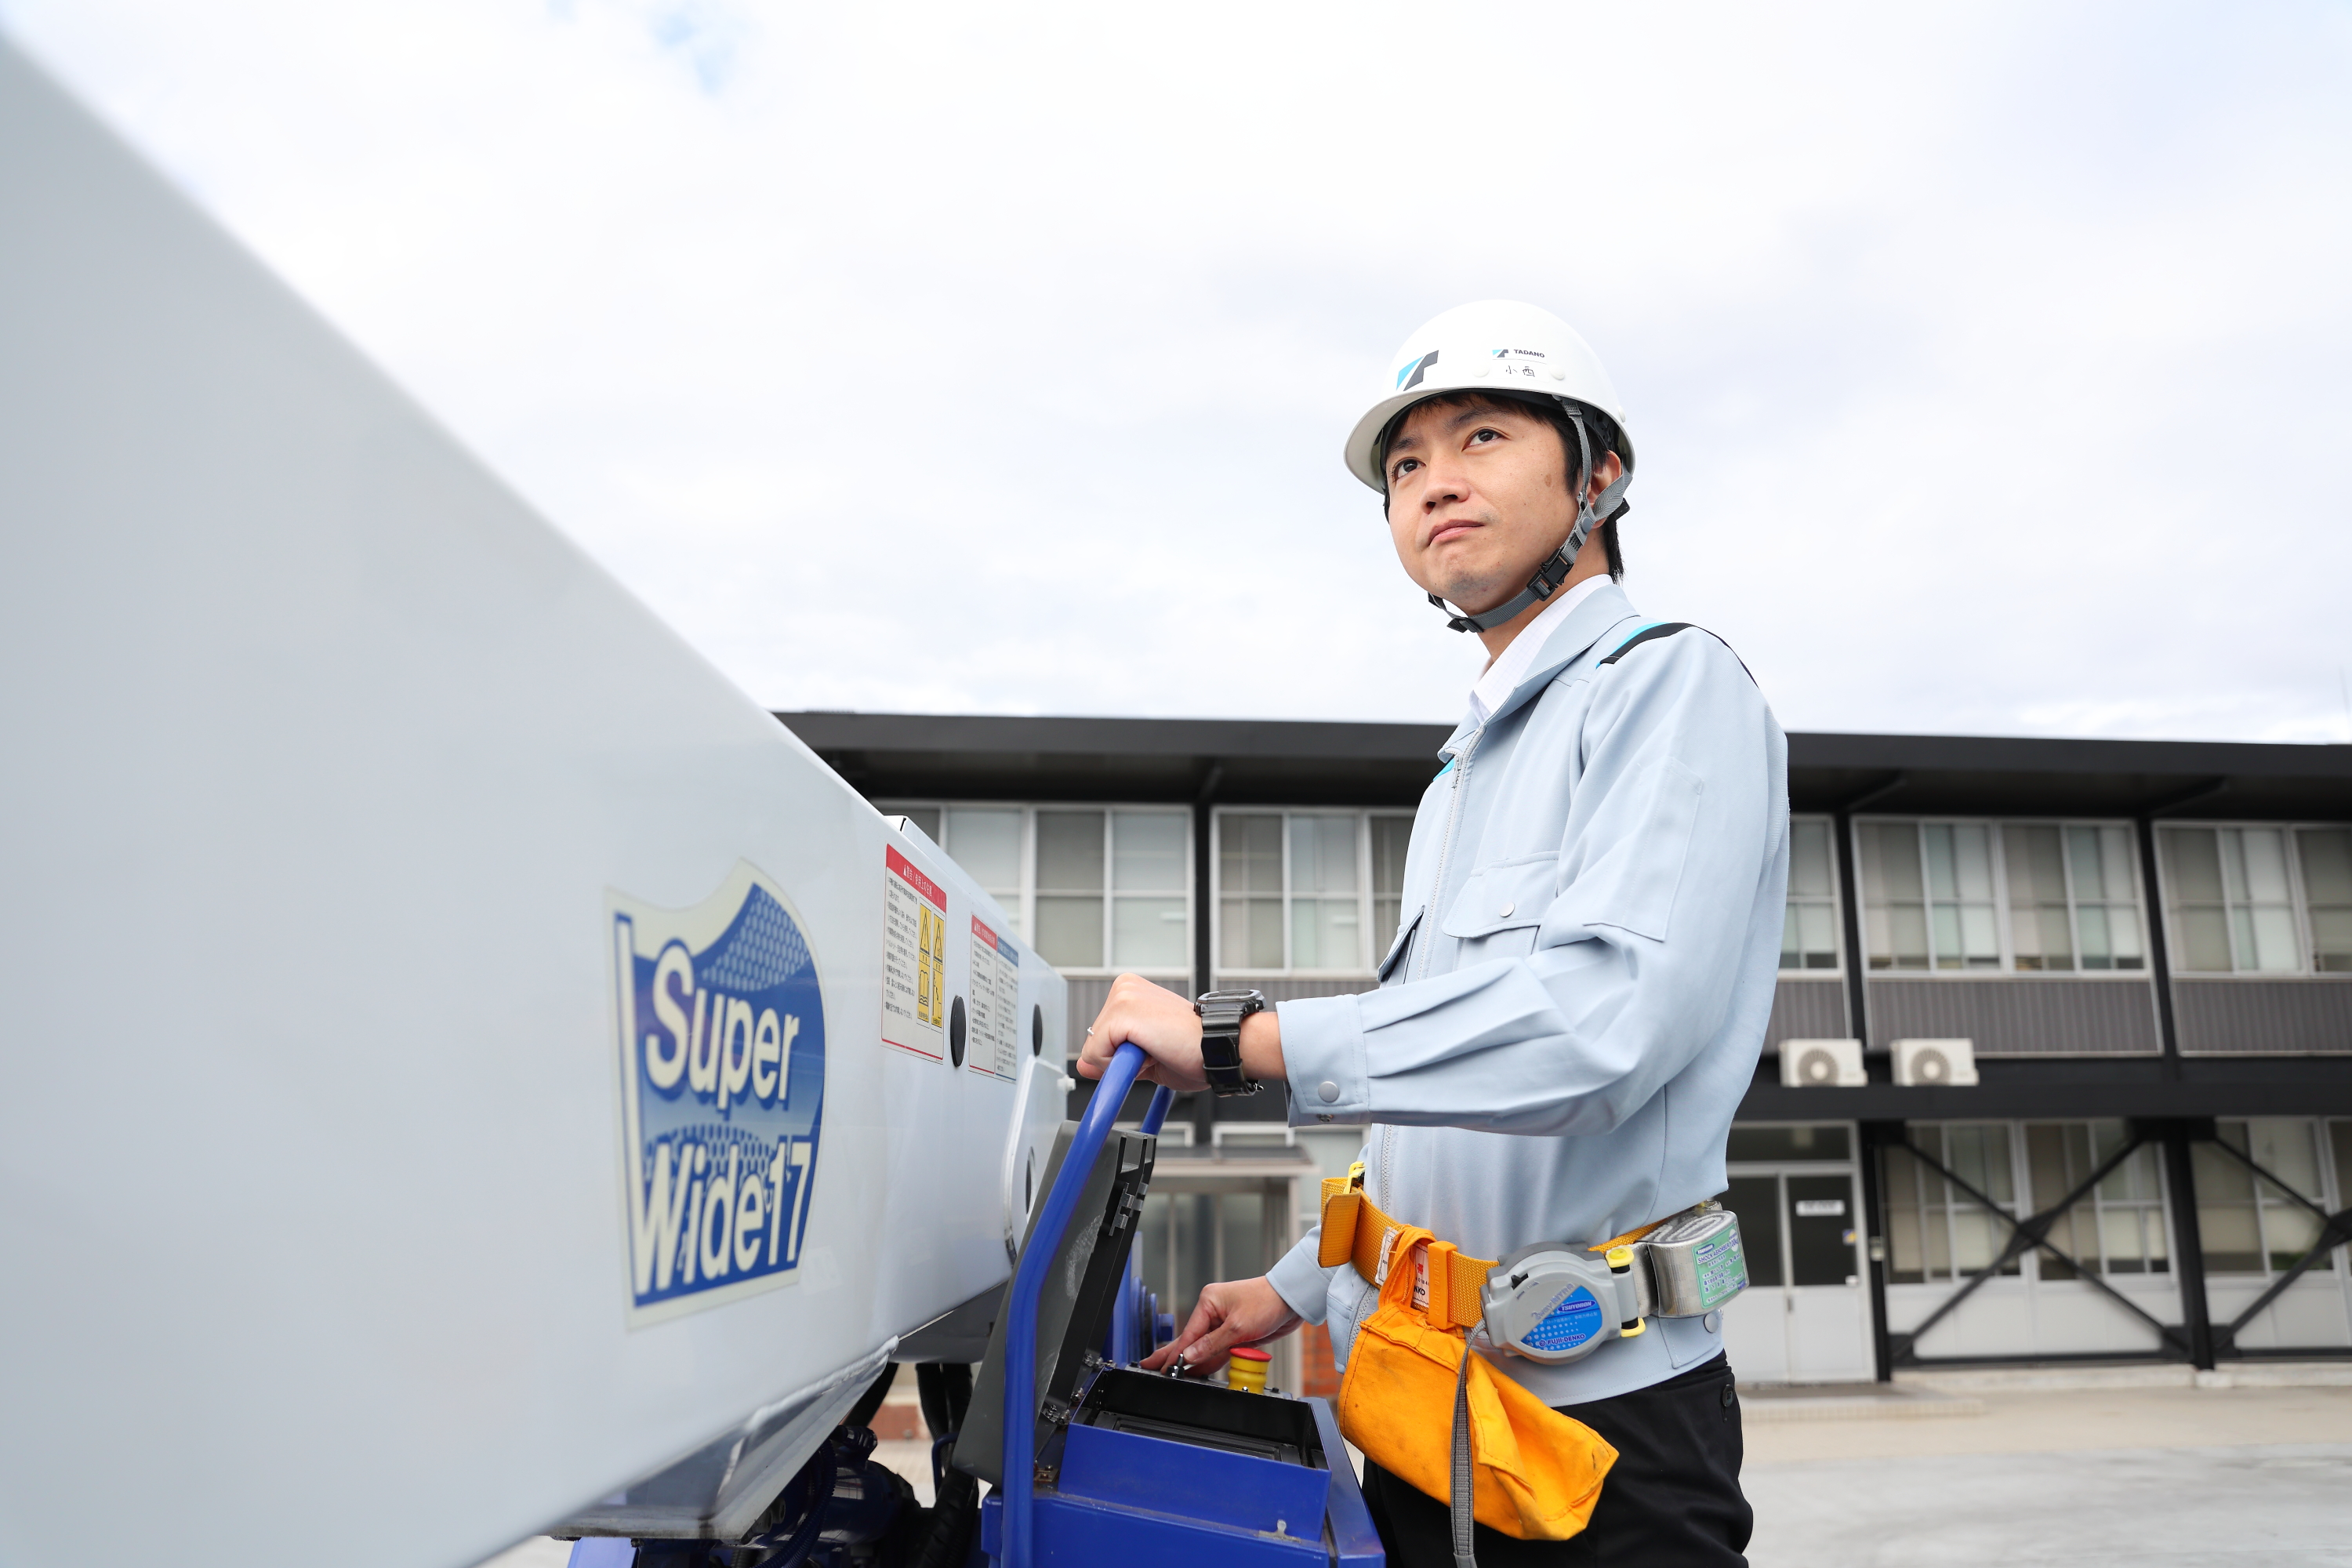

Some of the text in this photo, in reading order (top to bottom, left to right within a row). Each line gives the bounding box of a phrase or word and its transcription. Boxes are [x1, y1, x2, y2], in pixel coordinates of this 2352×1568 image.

[1513, 349, 1545, 358] TADANO
[644, 944, 800, 1110] Super
[1697, 1253, 1713, 1264] SHOCK
[1414, 1285, 1426, 1296] NKO
[1561, 1300, 1592, 1312] TSUYORON
